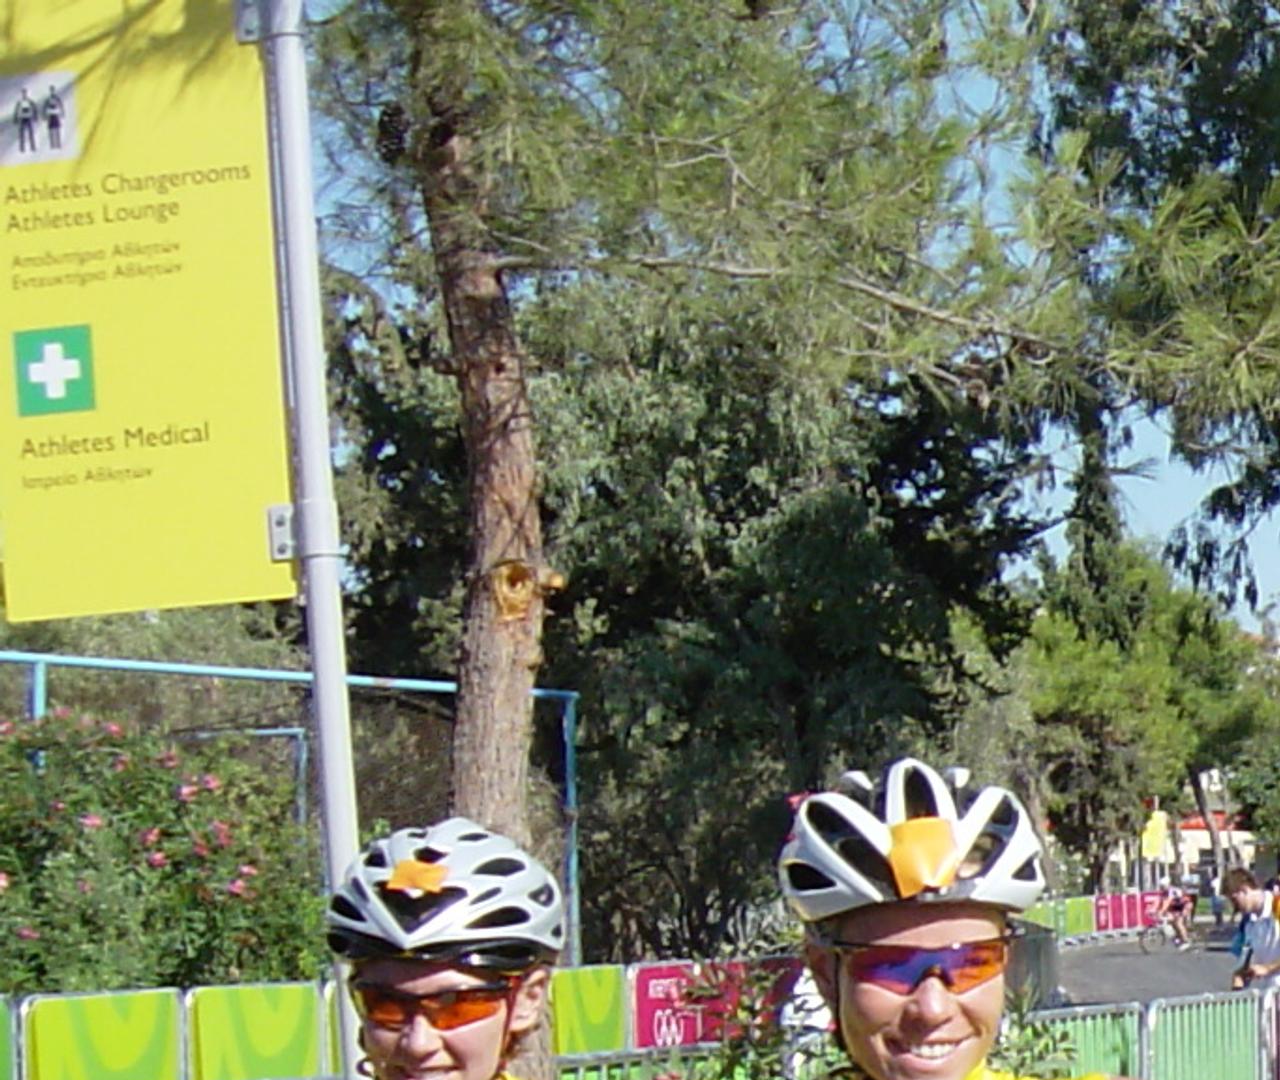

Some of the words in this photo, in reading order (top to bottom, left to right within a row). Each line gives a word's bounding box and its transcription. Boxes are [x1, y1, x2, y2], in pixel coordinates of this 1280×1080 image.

[5, 182, 93, 205] Athletes
[101, 164, 250, 194] Changerooms
[7, 210, 95, 233] Athletes
[102, 201, 180, 223] Lounge
[20, 435, 116, 459] Athletes
[124, 421, 210, 448] Medical
